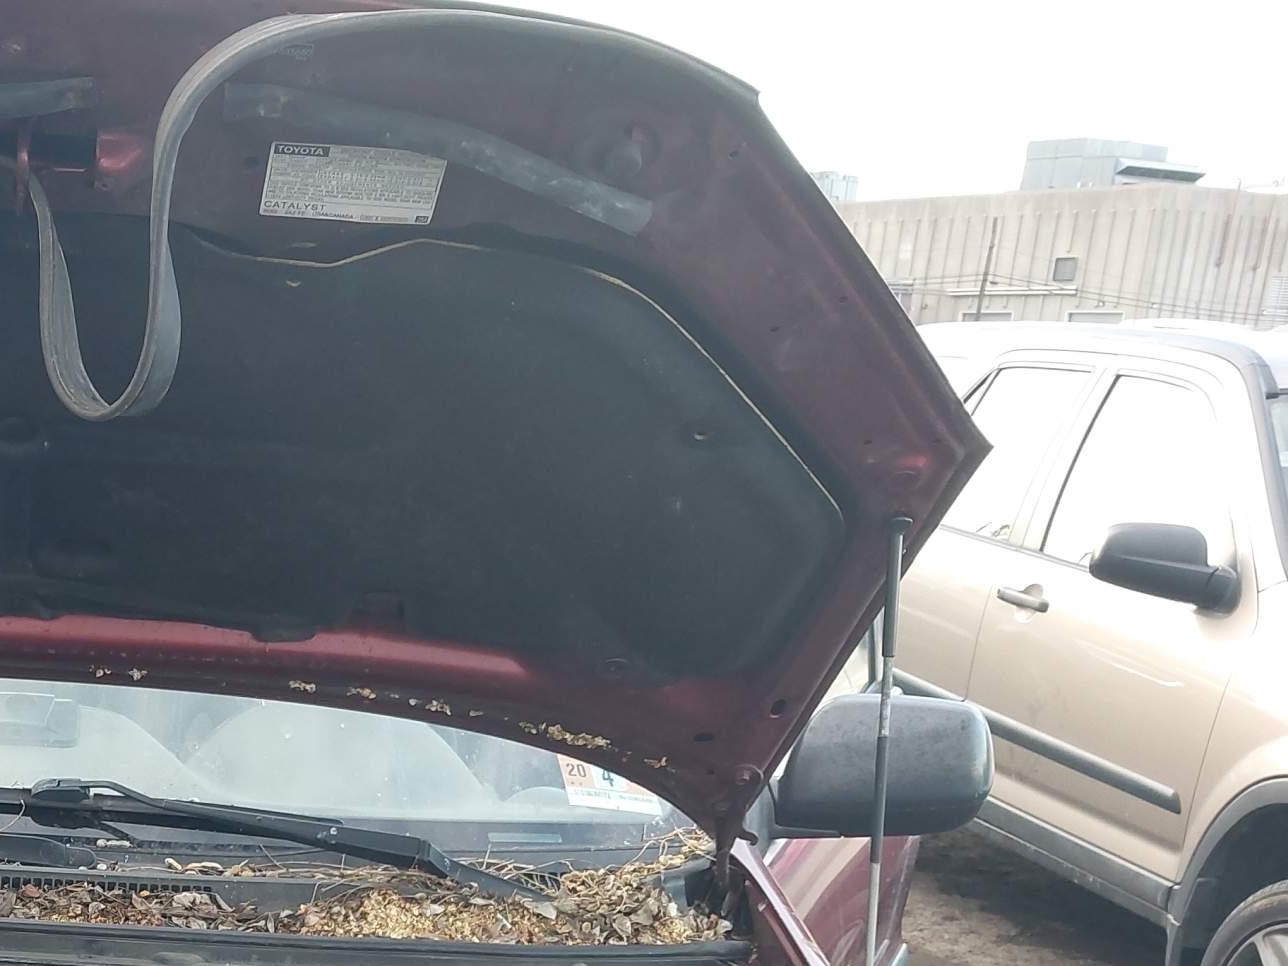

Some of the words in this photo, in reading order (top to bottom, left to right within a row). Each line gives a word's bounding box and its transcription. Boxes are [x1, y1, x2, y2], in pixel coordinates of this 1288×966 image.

[277, 145, 324, 155] TOYOTA
[263, 200, 327, 211] CATALYST
[566, 763, 587, 778] 20
